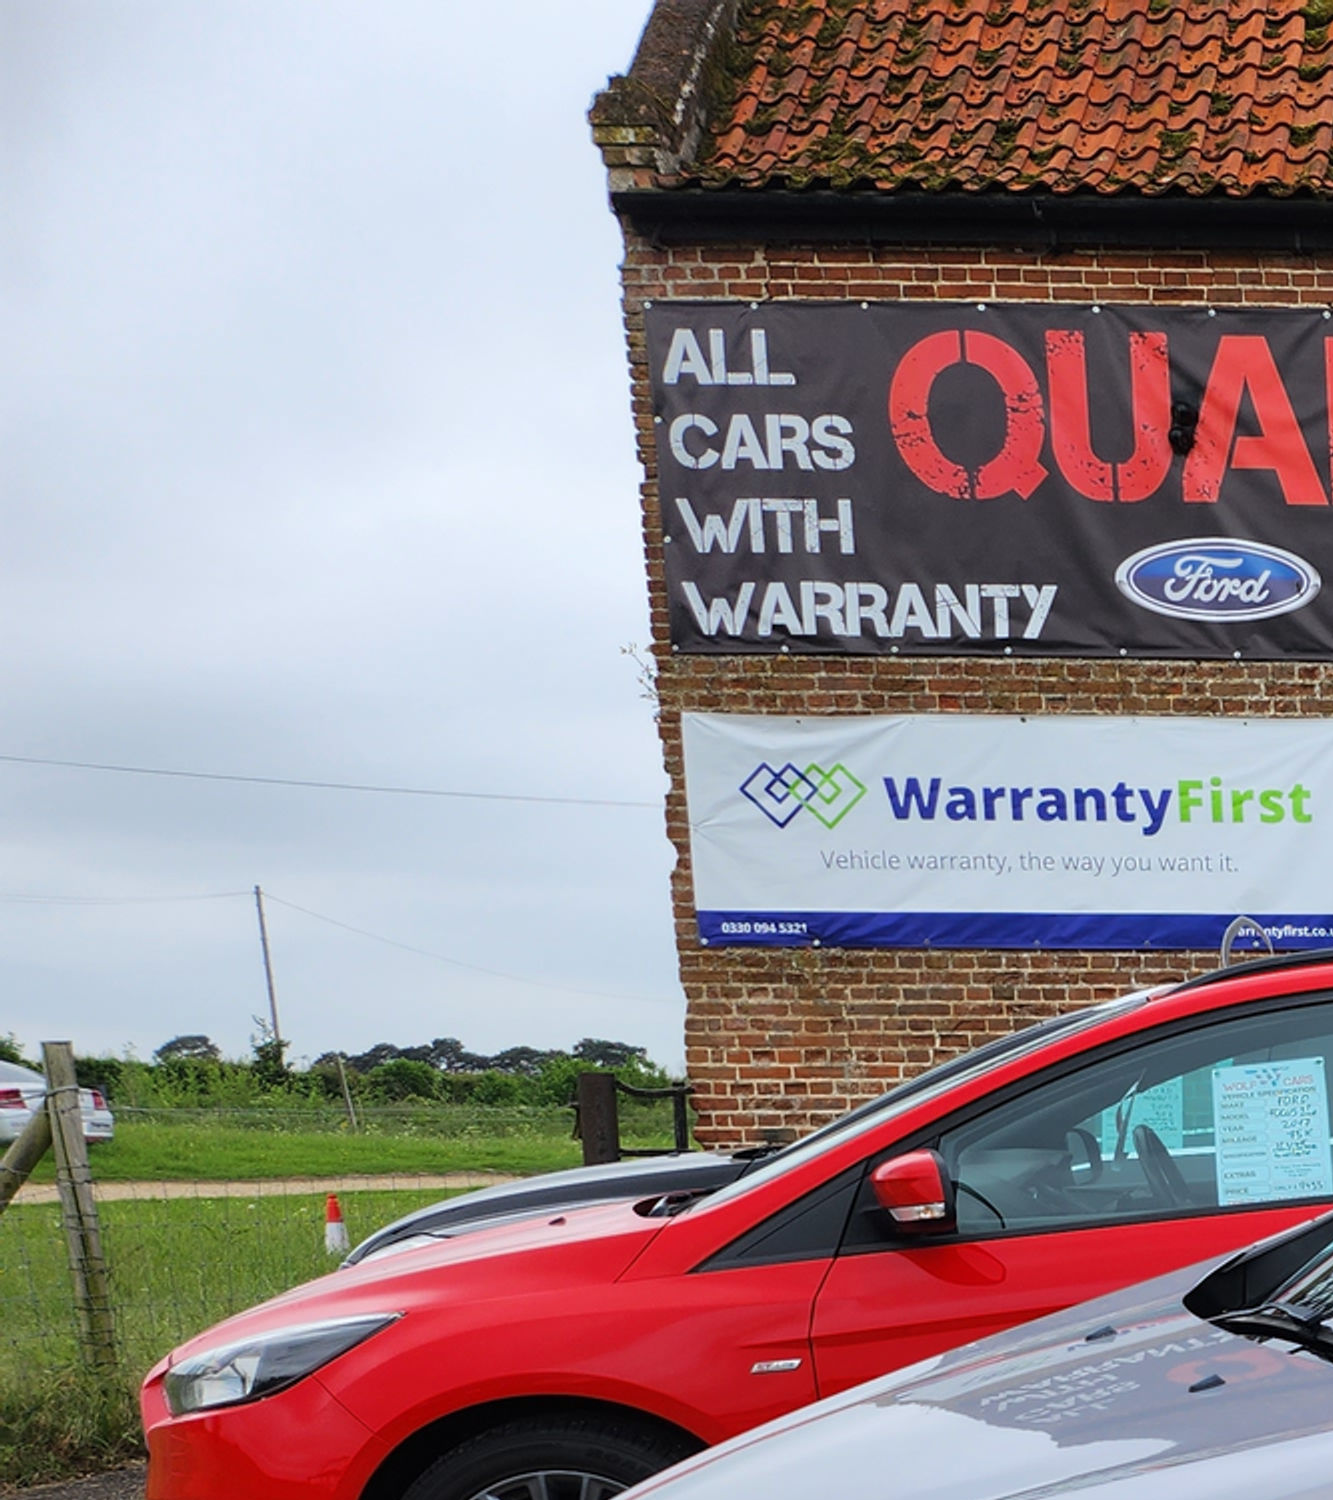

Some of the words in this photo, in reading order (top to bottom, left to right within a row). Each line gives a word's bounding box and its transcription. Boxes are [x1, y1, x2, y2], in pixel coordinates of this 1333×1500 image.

[662, 328, 796, 385] ALL
[669, 414, 855, 470] CARS
[676, 497, 856, 555] WITH
[1162, 554, 1270, 605] Ford
[682, 581, 1058, 640] WARRANTY
[883, 775, 1313, 836] WarrantyFirst
[820, 849, 900, 872] Vehicle
[906, 851, 1012, 876] warranty,
[1019, 850, 1056, 872] the
[1061, 854, 1105, 876] way
[1111, 854, 1153, 876] you
[1157, 854, 1213, 873] want
[1218, 852, 1239, 873] it.
[721, 922, 750, 934] 0330
[753, 922, 777, 934] 094
[778, 922, 808, 934] 5321
